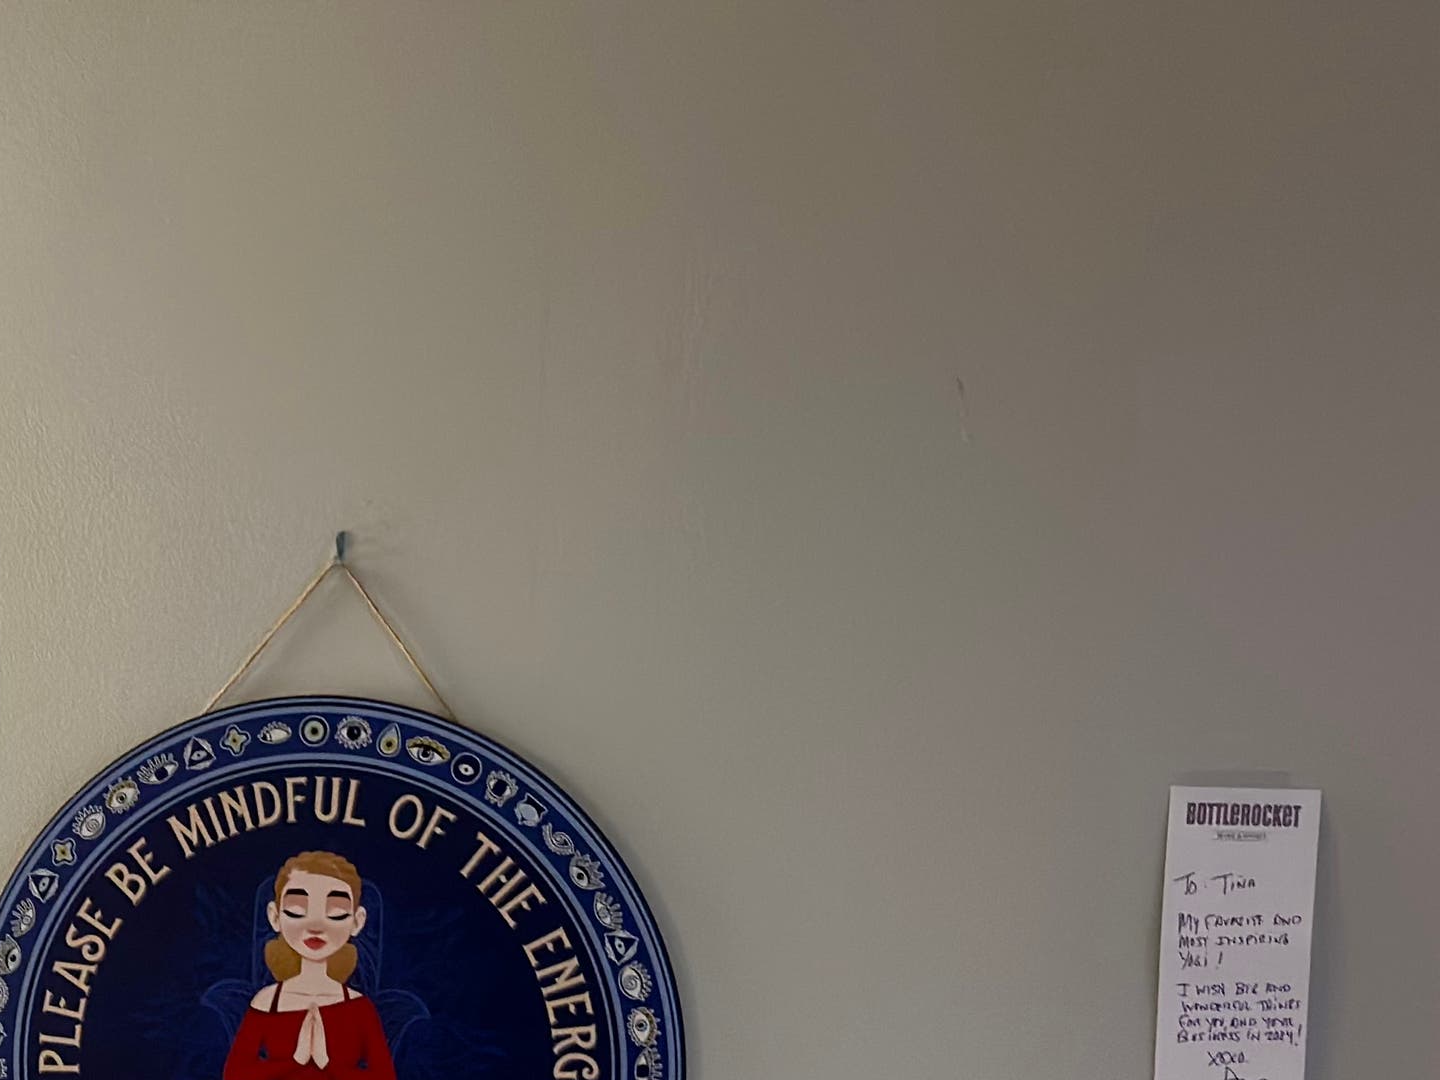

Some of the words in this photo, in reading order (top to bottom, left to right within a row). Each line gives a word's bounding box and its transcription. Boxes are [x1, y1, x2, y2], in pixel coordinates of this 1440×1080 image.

[37, 901, 122, 1076] PLEASE
[106, 837, 170, 906] BE
[166, 776, 366, 860] MINDFUL
[388, 794, 457, 850] OF
[459, 832, 547, 930] THE
[1273, 913, 1303, 926] AND
[1176, 983, 1190, 997] I
